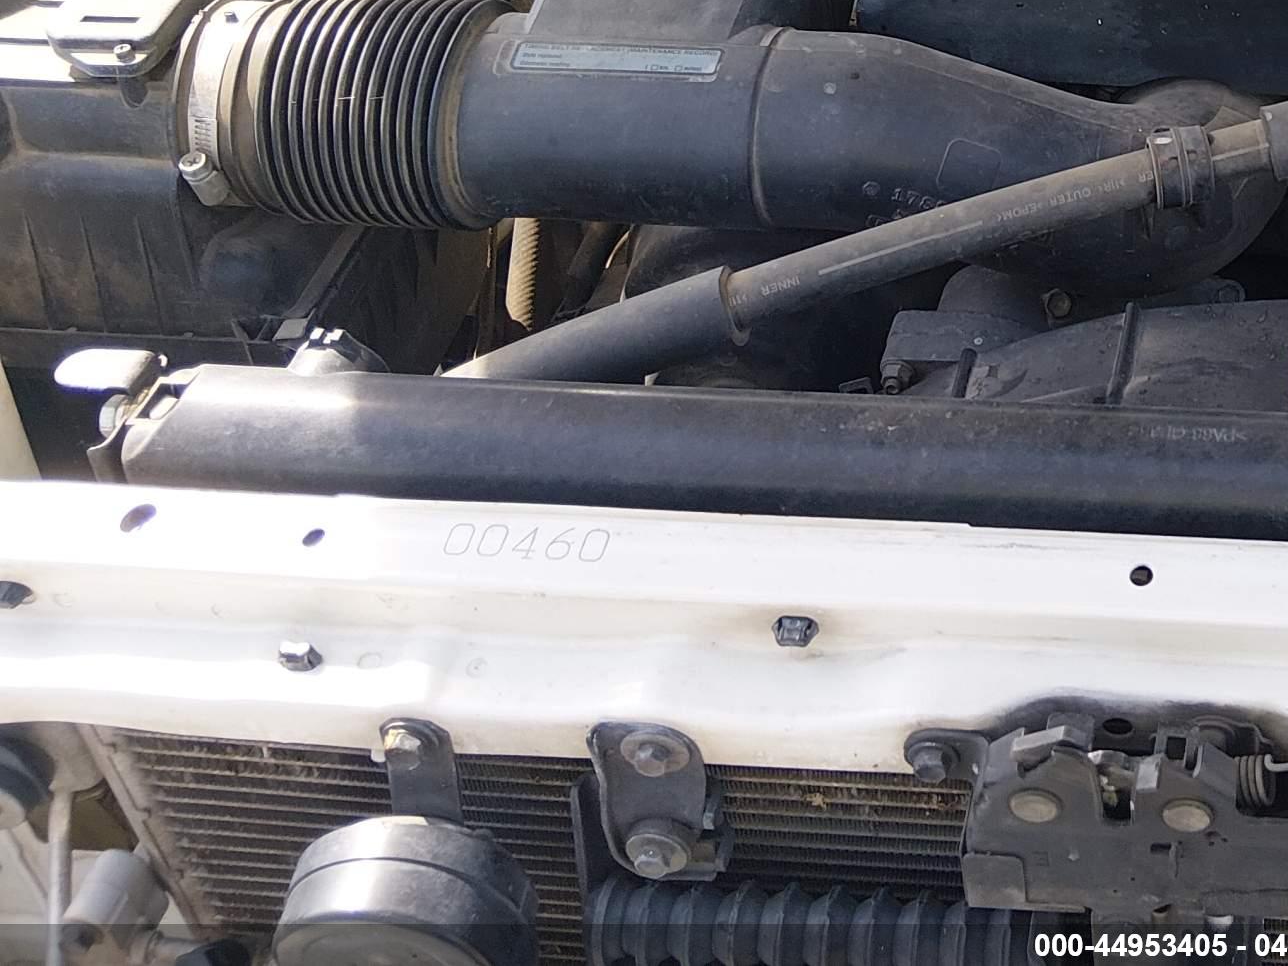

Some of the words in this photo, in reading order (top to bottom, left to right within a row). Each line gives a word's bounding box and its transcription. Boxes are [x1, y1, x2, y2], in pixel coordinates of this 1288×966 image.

[1050, 186, 1092, 206] OUTER
[761, 275, 800, 296] INNER
[443, 523, 610, 562] 00460
